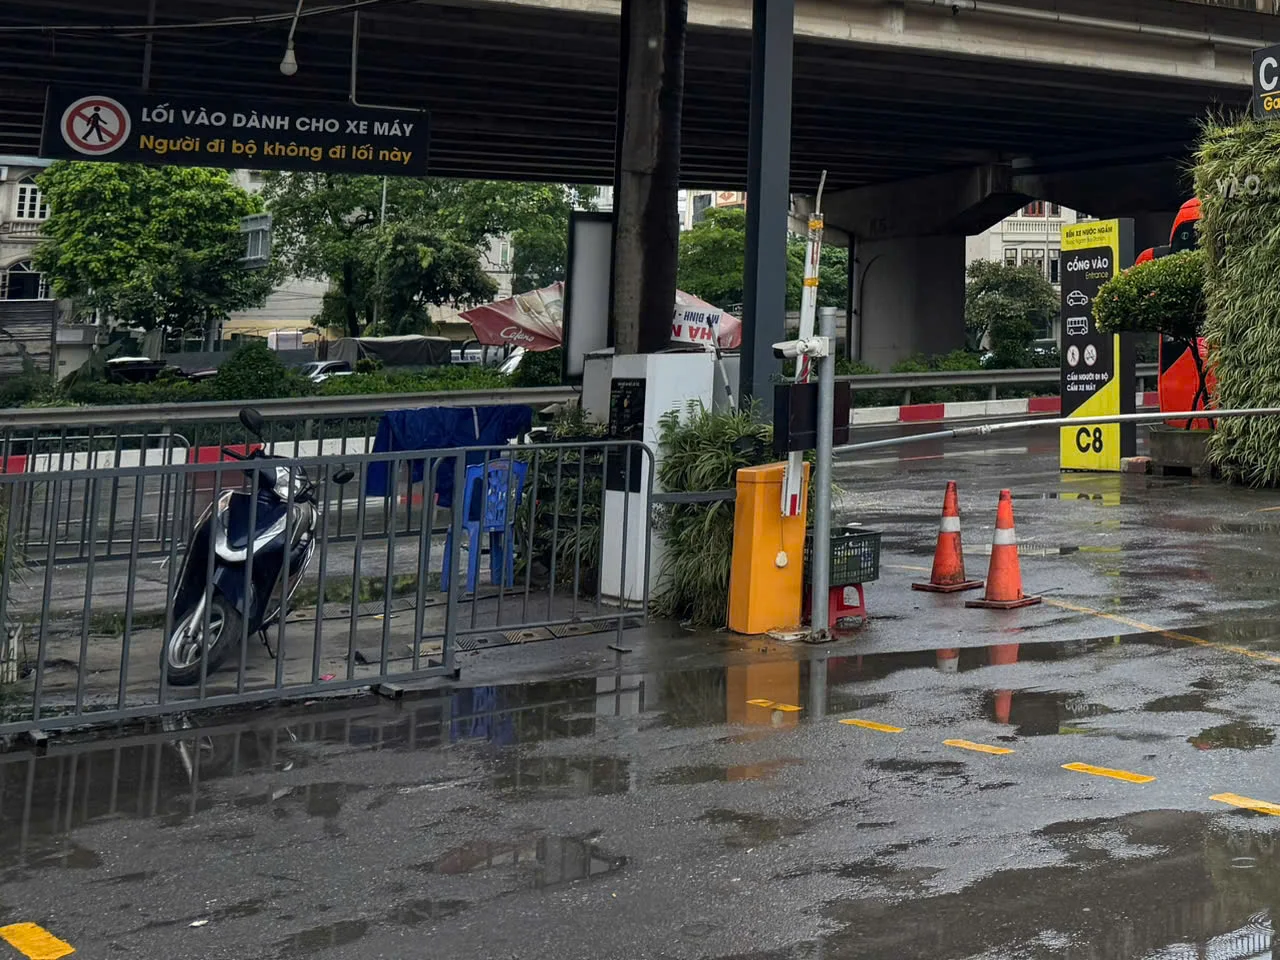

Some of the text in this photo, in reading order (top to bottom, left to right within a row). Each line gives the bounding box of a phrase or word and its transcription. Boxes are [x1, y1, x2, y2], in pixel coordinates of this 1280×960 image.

[141, 102, 414, 138] LỐI VÀO DÀNH CHO XE MÁY
[139, 134, 413, 166] Người đi bộ không đi lối này
[1066, 255, 1109, 272] CỔNG VÀO
[1085, 271, 1109, 280] Entrance
[1075, 426, 1104, 453] C8
